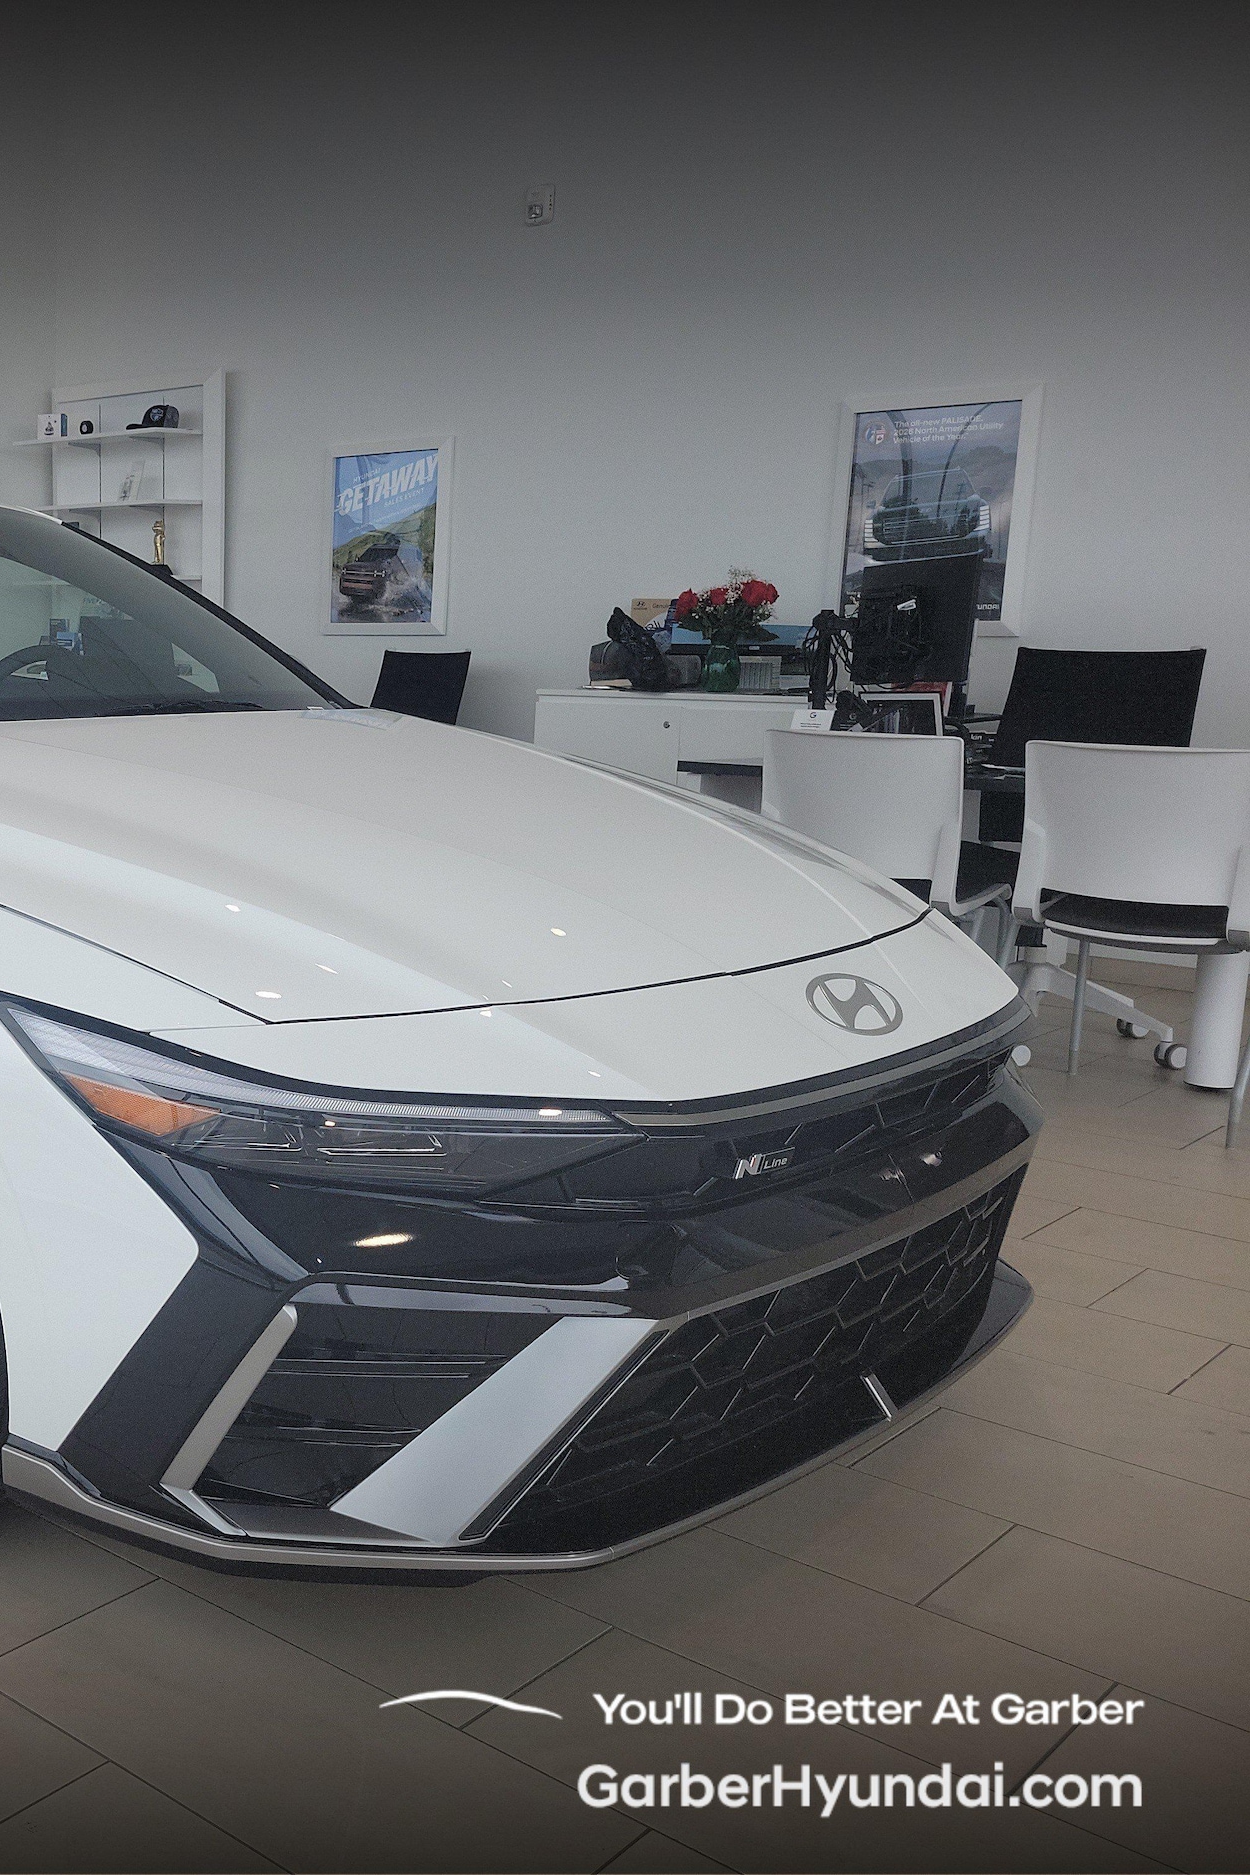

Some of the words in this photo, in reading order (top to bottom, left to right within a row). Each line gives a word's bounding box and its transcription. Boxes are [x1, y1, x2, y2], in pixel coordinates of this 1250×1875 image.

[915, 425, 938, 434] North
[980, 421, 1004, 430] Utility
[893, 434, 921, 444] Vehicle
[922, 434, 931, 442] of
[932, 433, 945, 442] the
[337, 454, 439, 517] GETAWAY
[384, 495, 403, 508] SALES
[404, 487, 425, 501] EVENT
[733, 1153, 762, 1180] N
[763, 1156, 788, 1170] Line
